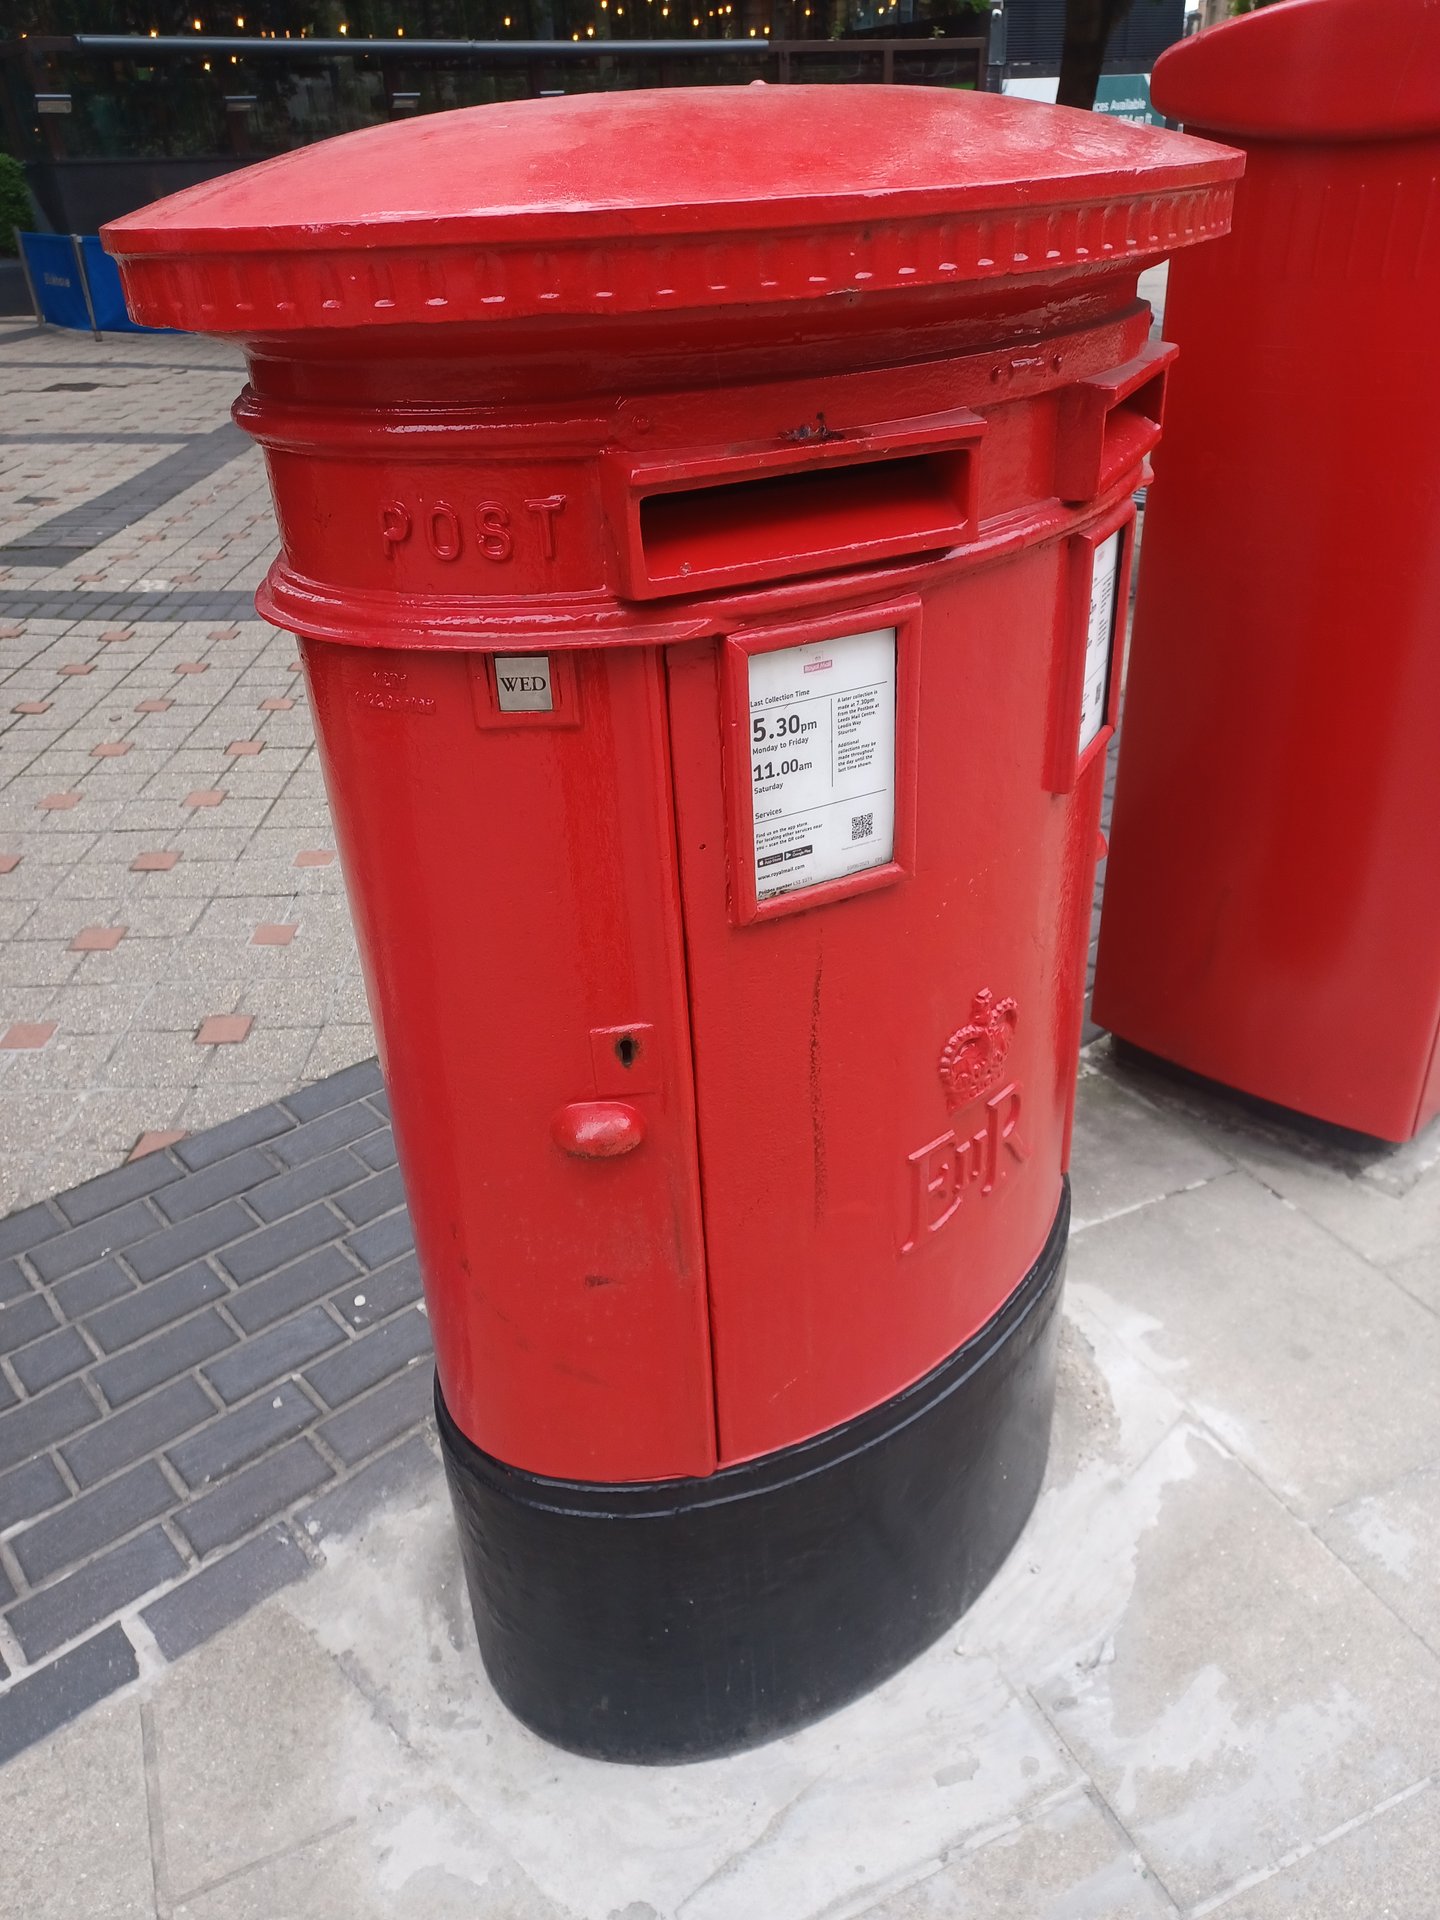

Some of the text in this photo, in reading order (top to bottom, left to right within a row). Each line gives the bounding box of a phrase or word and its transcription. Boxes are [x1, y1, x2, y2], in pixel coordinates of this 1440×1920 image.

[1110, 98, 1146, 111] Available
[382, 494, 567, 561] POST
[500, 676, 547, 692] WED
[750, 700, 764, 708] Last
[765, 693, 793, 704] Collection
[853, 691, 873, 700] collection
[753, 714, 817, 742] 5.30pm
[753, 745, 778, 755] Monday
[789, 737, 809, 746] Friday
[838, 739, 860, 748] Additional
[838, 746, 860, 754] collections
[851, 748, 874, 757] throughout
[753, 759, 812, 782] 11.00am
[754, 783, 783, 795] Saturday
[755, 808, 782, 819] Services
[765, 834, 781, 842] locating
[758, 864, 805, 880] www.royalmail.com
